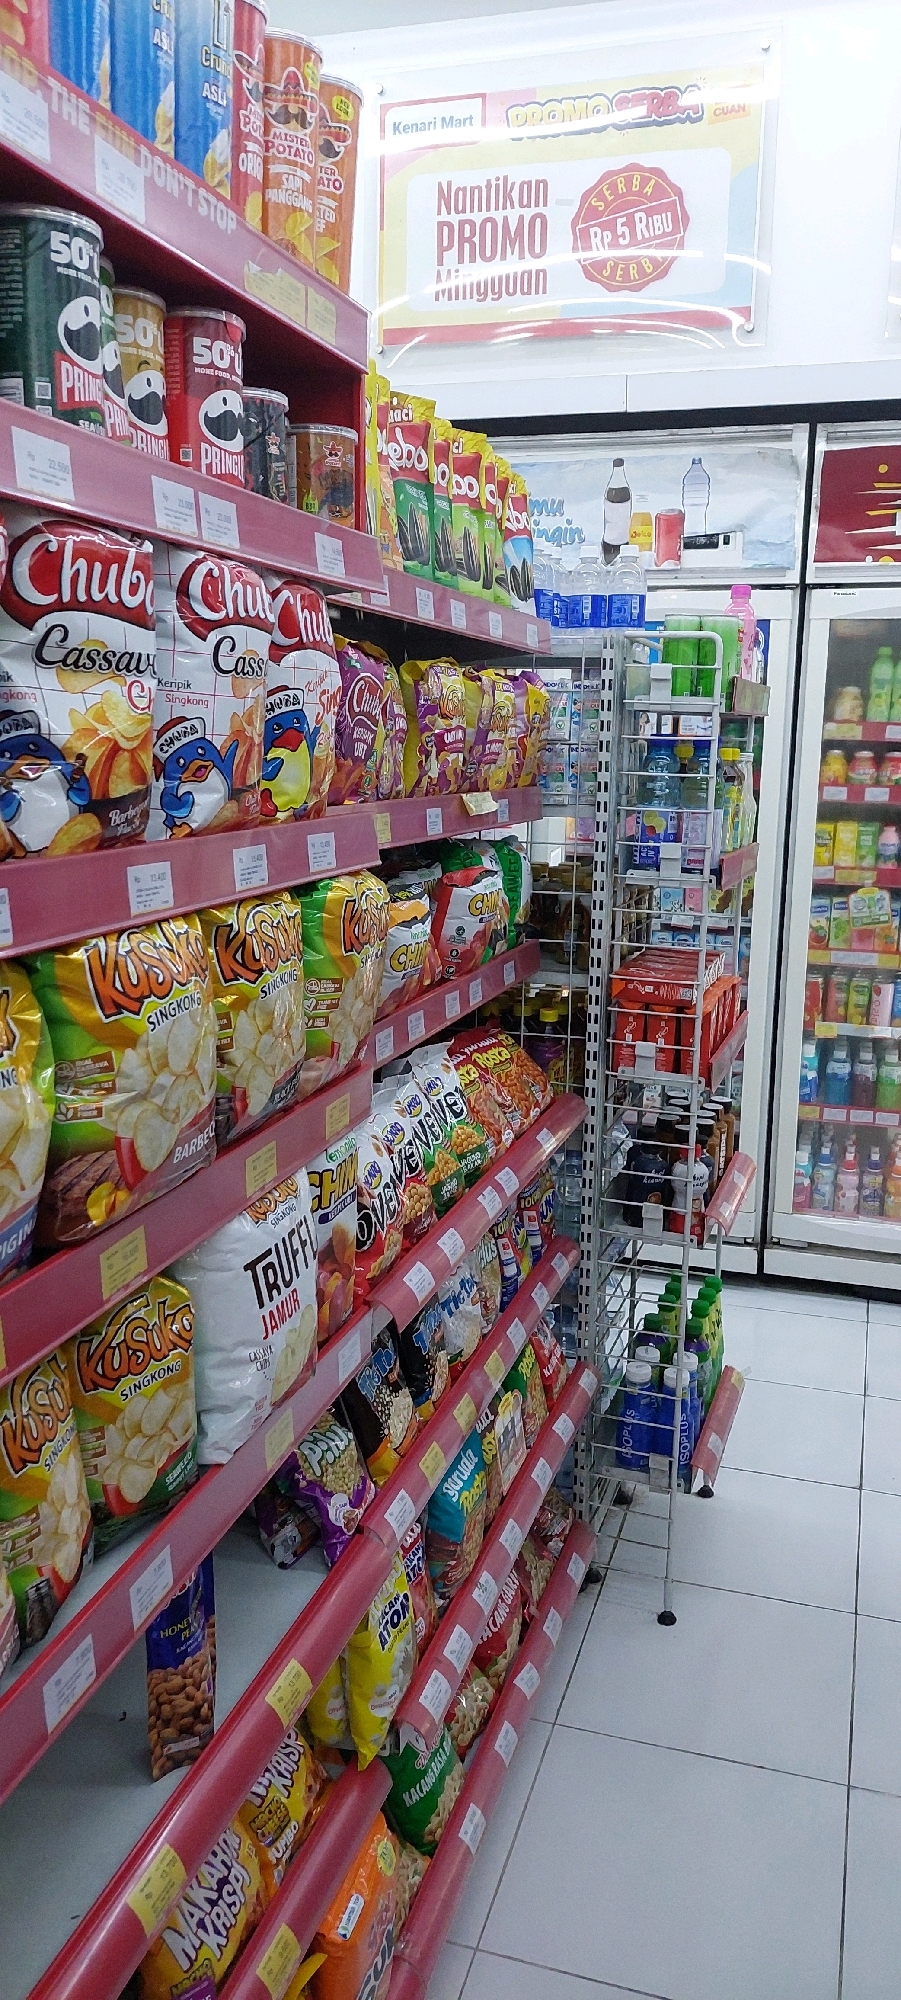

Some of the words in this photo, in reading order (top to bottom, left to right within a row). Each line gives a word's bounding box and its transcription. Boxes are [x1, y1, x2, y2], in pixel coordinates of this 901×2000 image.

[202, 82, 227, 107] ASLI
[713, 103, 746, 117] CUAN
[392, 118, 437, 137] Kenari
[441, 113, 474, 130] Mart
[47, 75, 92, 136] THE
[196, 188, 237, 236] STOP
[264, 141, 315, 165] POTATO
[282, 173, 303, 193] SAPI
[436, 175, 549, 217] Nantikan
[591, 173, 656, 212] SERBA
[436, 211, 548, 268] PROMO
[589, 225, 613, 252] Rp
[615, 215, 632, 246] 5
[434, 266, 548, 303] Mingguan
[157, 677, 192, 691] Keripik
[165, 693, 209, 709] Singkong
[146, 991, 202, 1032] SINGKONG
[262, 1287, 301, 1340] JAMUR
[120, 1360, 182, 1401] SINGKONG
[679, 1412, 693, 1466] ISOPLUS
[442, 1448, 479, 1503] garuda
[160, 1616, 193, 1640] HONEY
[403, 1768, 435, 1808] KACANG
